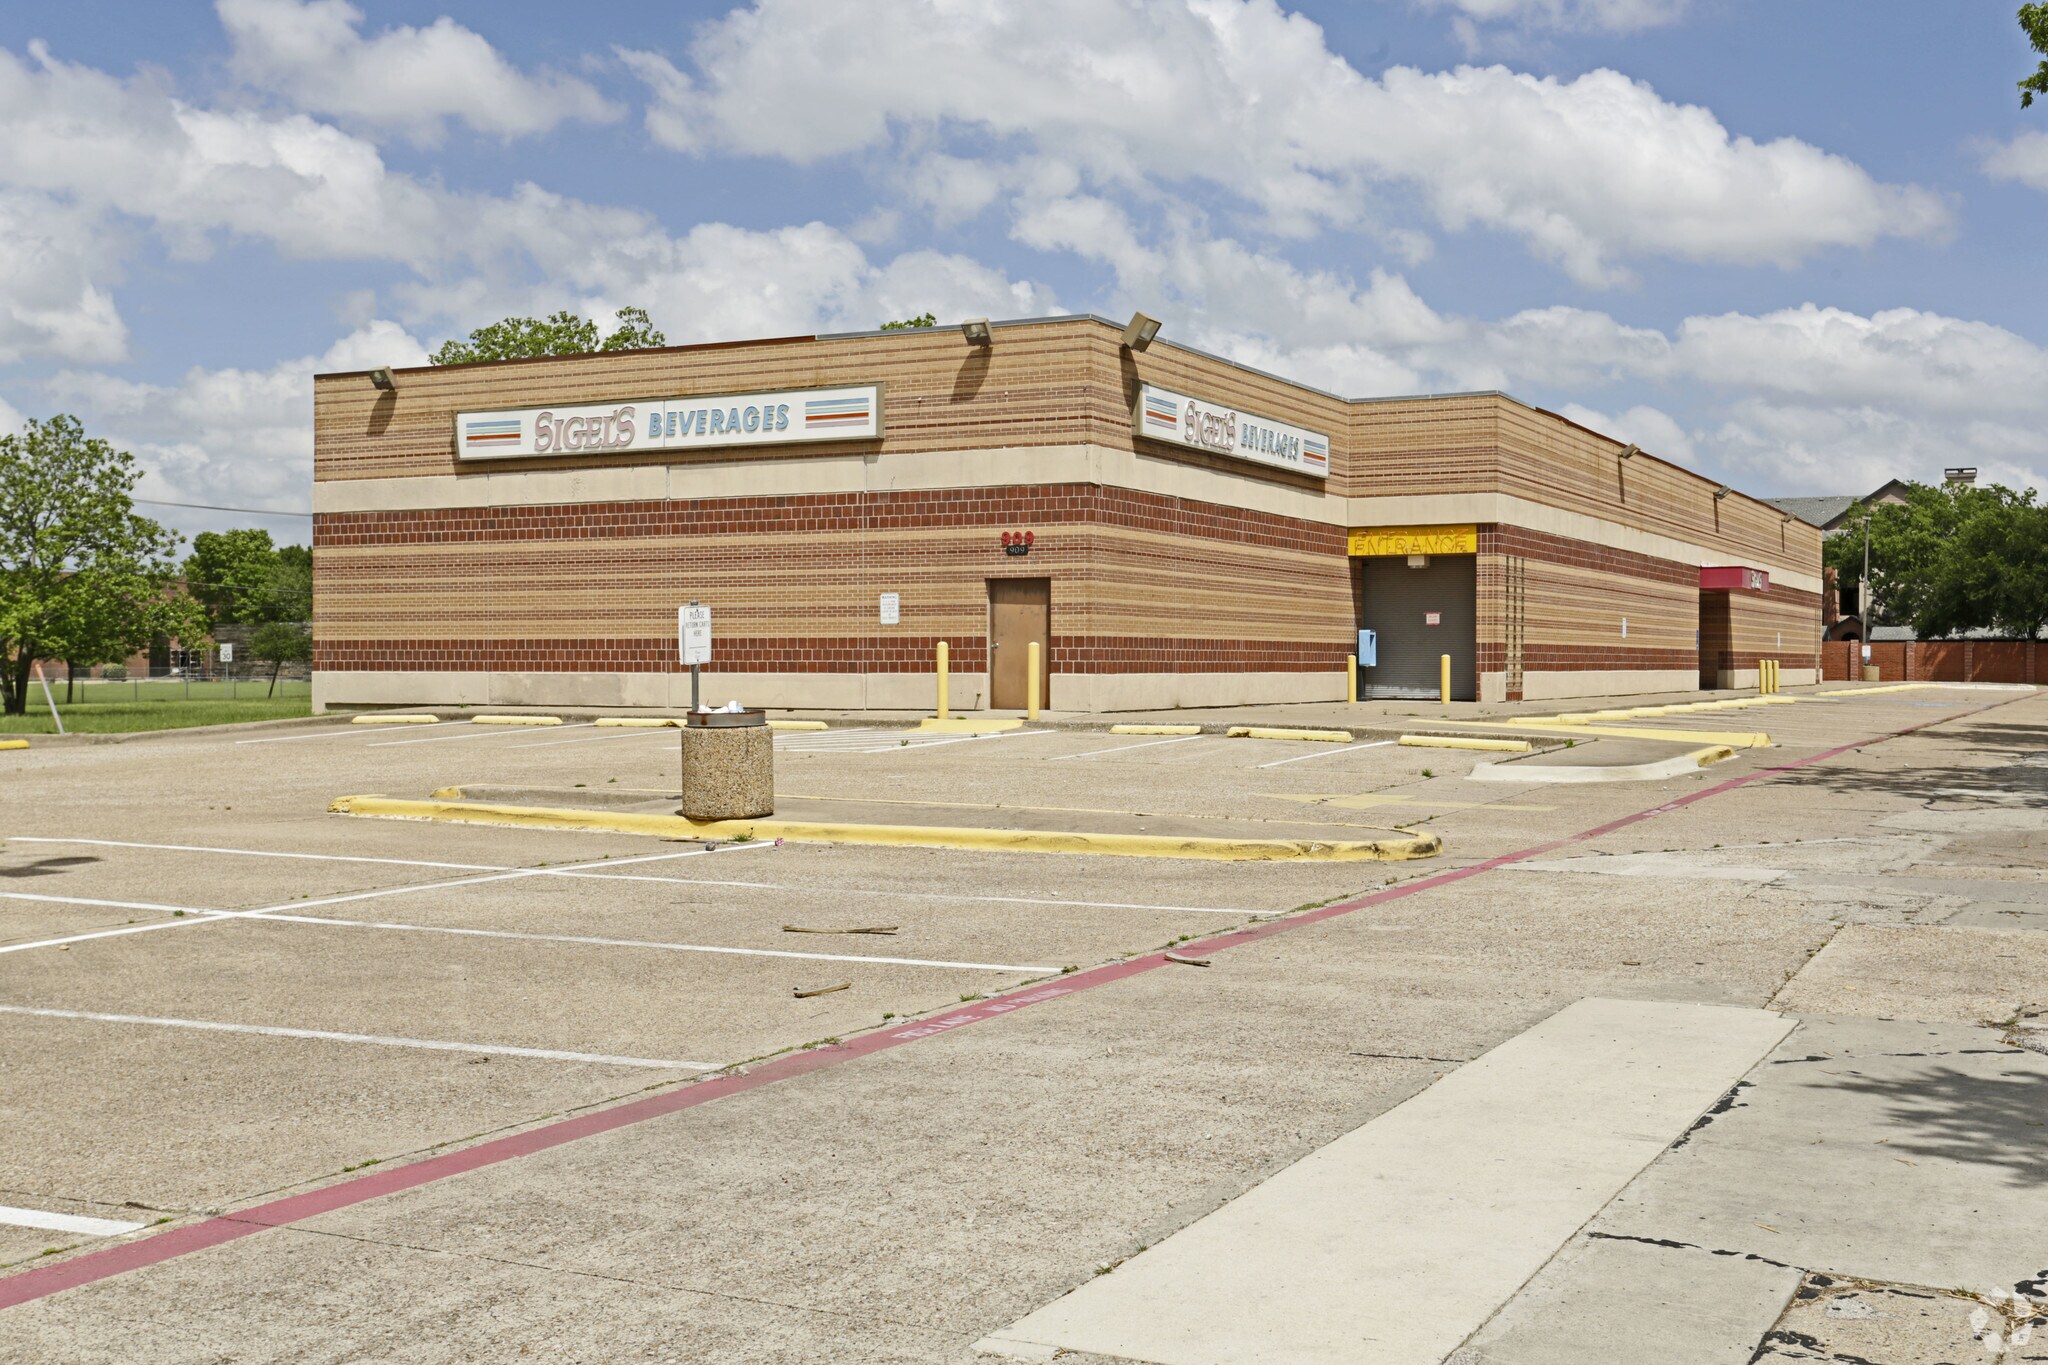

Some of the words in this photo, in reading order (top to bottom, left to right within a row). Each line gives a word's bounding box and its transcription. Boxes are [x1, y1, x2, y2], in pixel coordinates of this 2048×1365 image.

[534, 405, 636, 453] SIGEL'S
[648, 403, 790, 439] BEVERAGES
[1184, 400, 1236, 453] SIGEL'S
[1240, 422, 1300, 462] BEVERAGES
[1001, 531, 1034, 546] 909
[1354, 528, 1468, 555] ENTRANCE
[690, 610, 705, 619] PLEASE
